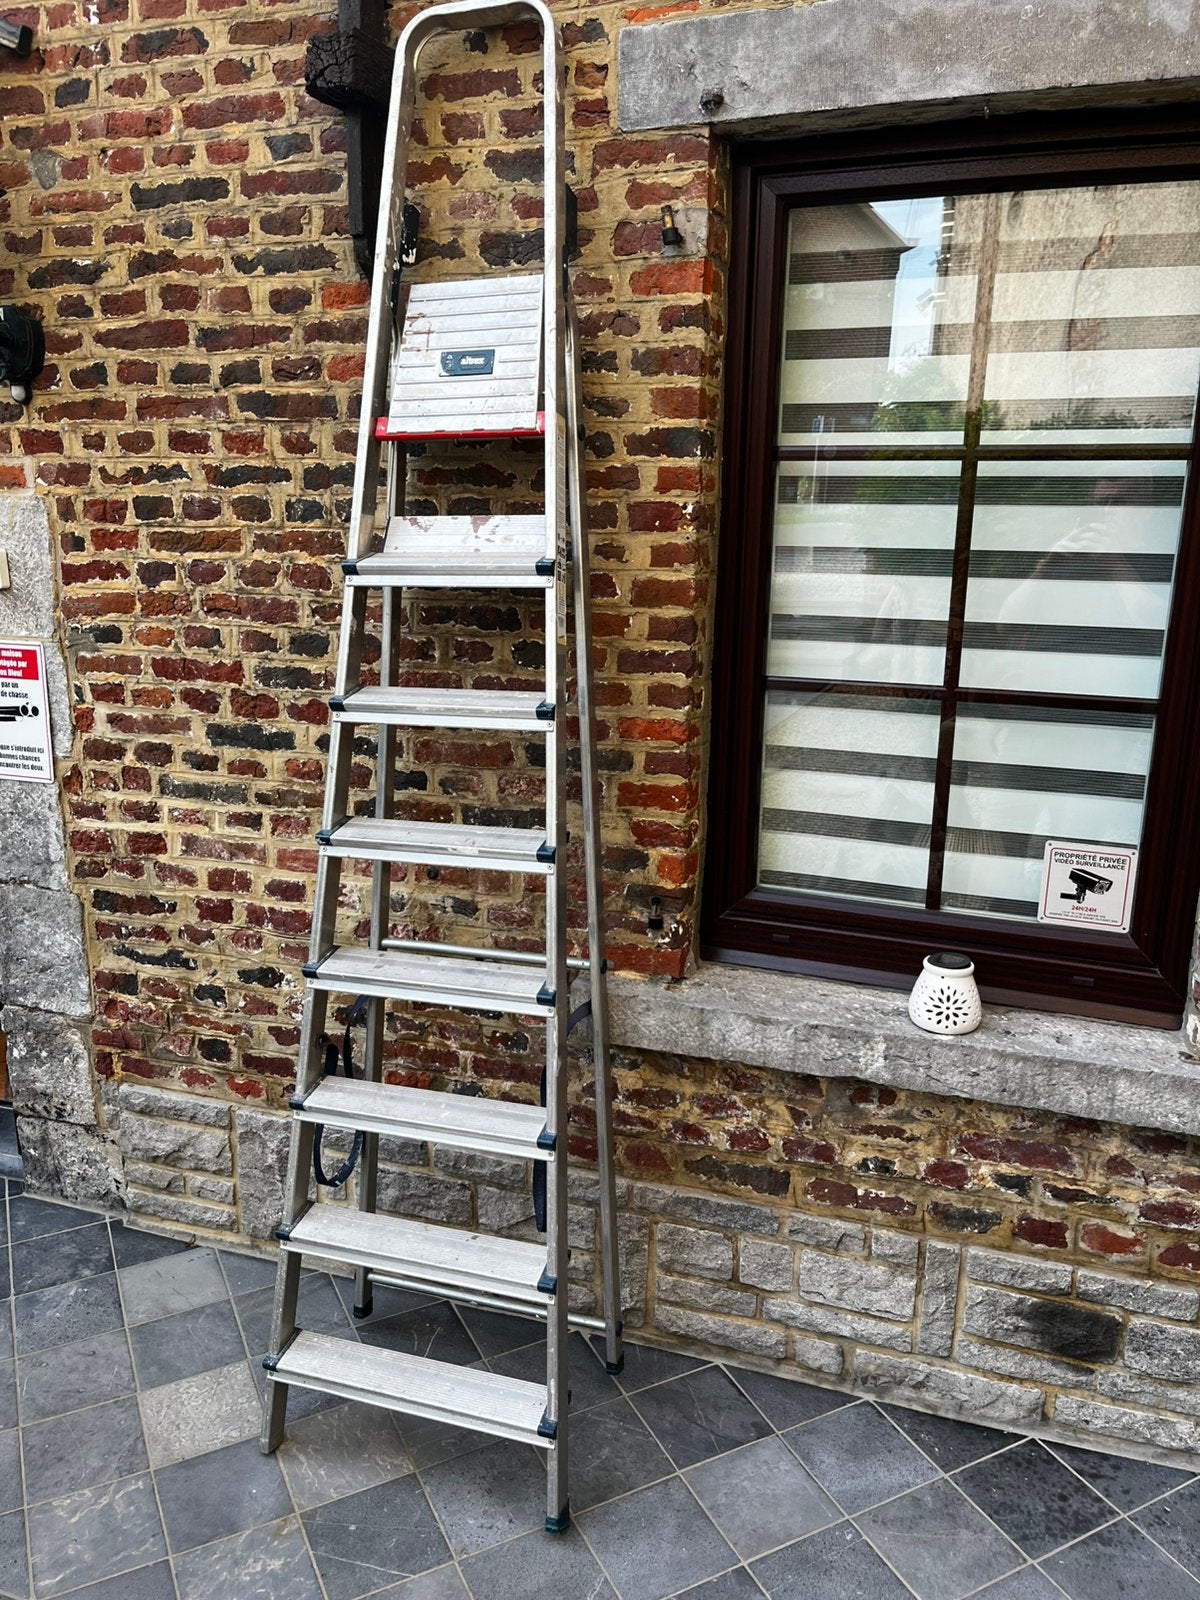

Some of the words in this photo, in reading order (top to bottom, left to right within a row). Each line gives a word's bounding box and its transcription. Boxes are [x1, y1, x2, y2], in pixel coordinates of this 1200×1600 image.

[461, 355, 485, 365] altrex
[1, 649, 22, 658] maison
[0, 659, 16, 668] tégée
[18, 660, 27, 669] par
[8, 668, 22, 677] Dieu!
[8, 691, 28, 699] chasse
[19, 754, 41, 762] chances
[1054, 851, 1097, 861] PROPRIÉTÉ
[1099, 856, 1127, 865] PRIVÉE
[1075, 860, 1126, 870] SURVEILLANCE
[1072, 905, 1097, 913] 24H/24H
